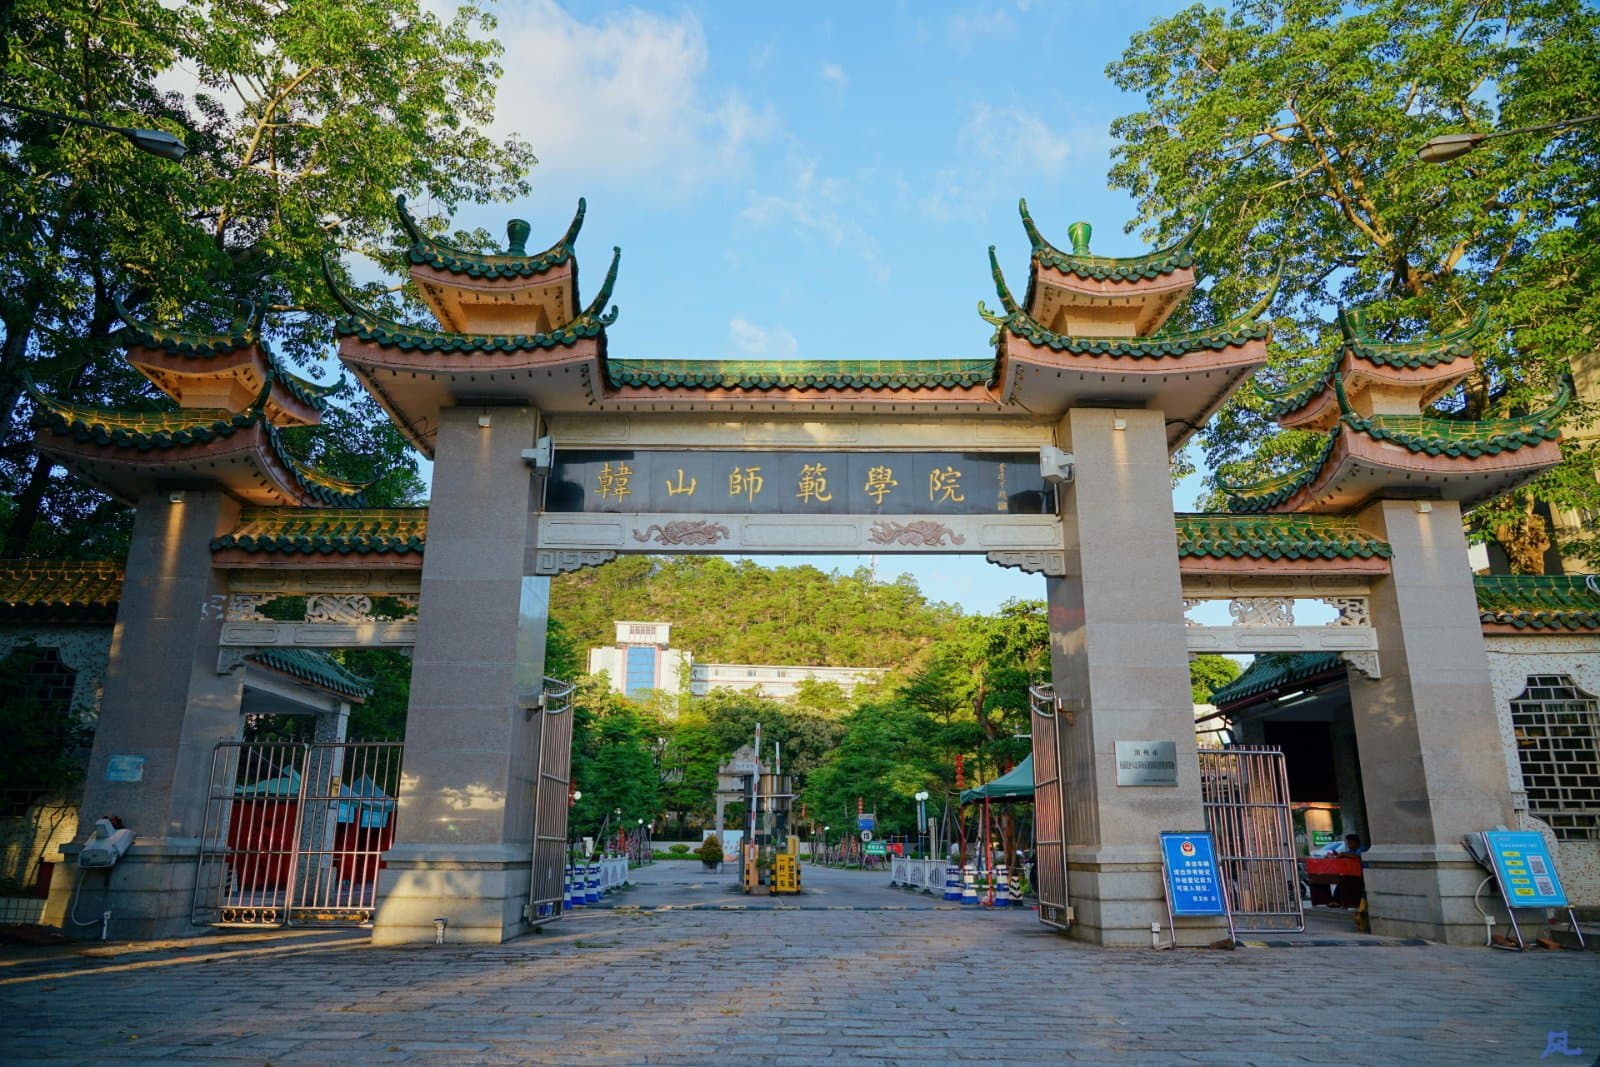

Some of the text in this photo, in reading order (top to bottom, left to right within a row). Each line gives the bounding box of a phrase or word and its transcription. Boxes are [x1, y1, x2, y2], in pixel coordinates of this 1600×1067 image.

[594, 460, 966, 504] 韓山師範學院
